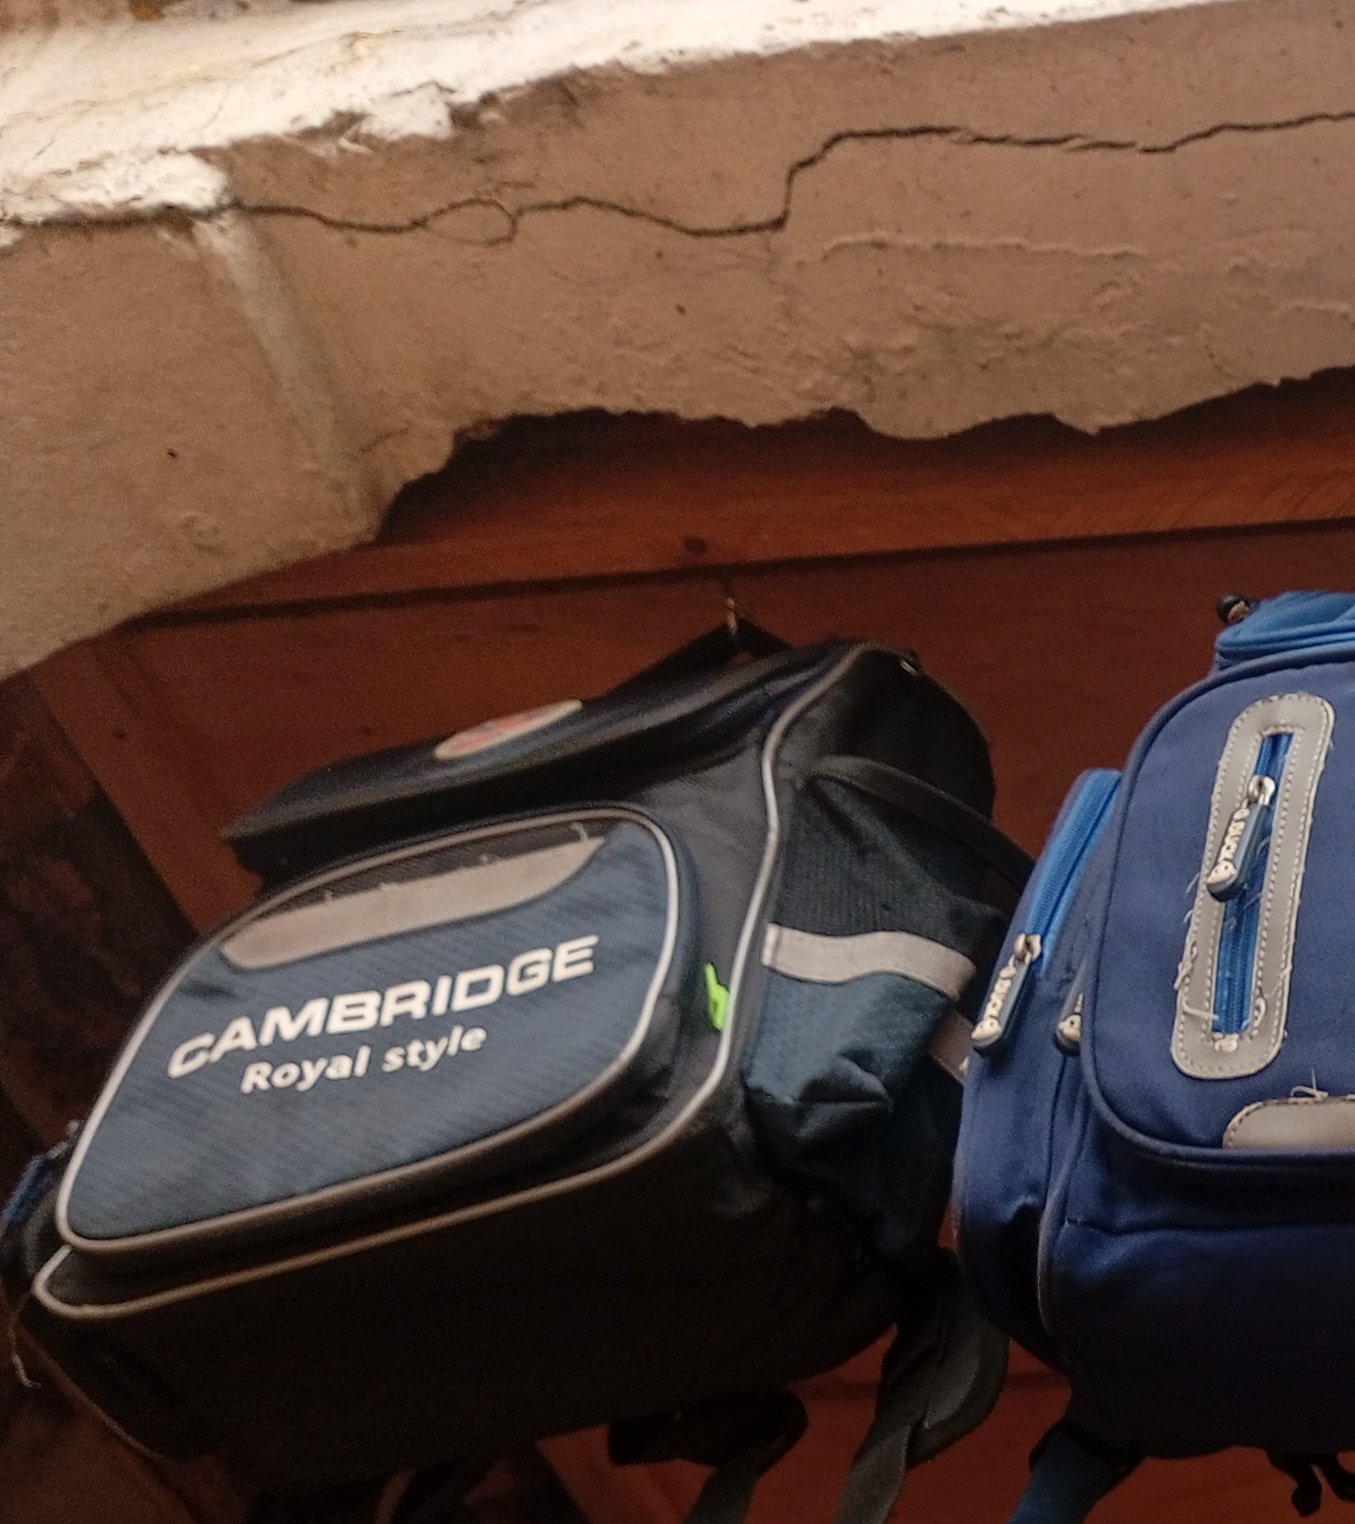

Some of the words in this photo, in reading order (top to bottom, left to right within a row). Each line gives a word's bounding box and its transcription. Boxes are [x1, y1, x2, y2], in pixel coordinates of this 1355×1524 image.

[167, 934, 600, 1079] CAMBRIDGE
[240, 1044, 372, 1094] Royal
[382, 1024, 488, 1072] style
